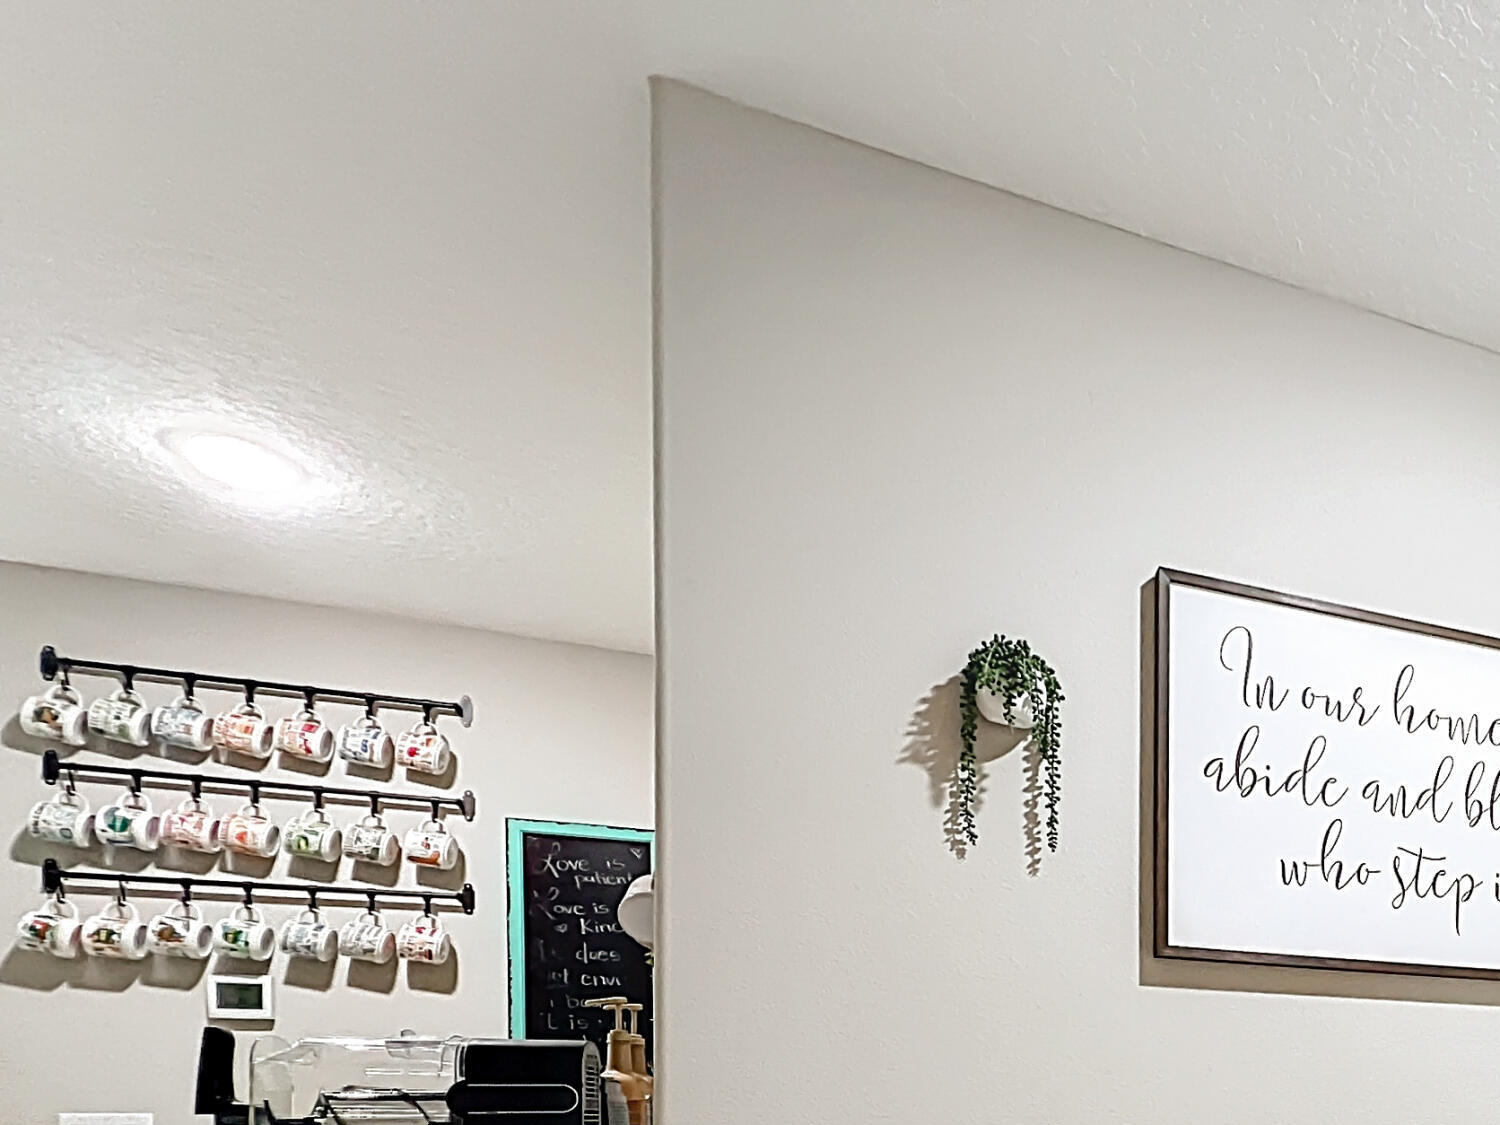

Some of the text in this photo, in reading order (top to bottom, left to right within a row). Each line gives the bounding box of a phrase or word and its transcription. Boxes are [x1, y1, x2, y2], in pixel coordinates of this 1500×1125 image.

[1219, 626, 1289, 712] In
[1301, 686, 1381, 727] our
[1203, 725, 1350, 807] abide
[1362, 755, 1455, 824] and
[535, 841, 626, 879] Love is
[592, 902, 610, 914] is
[1279, 818, 1382, 891] who
[1391, 846, 1483, 937] step
